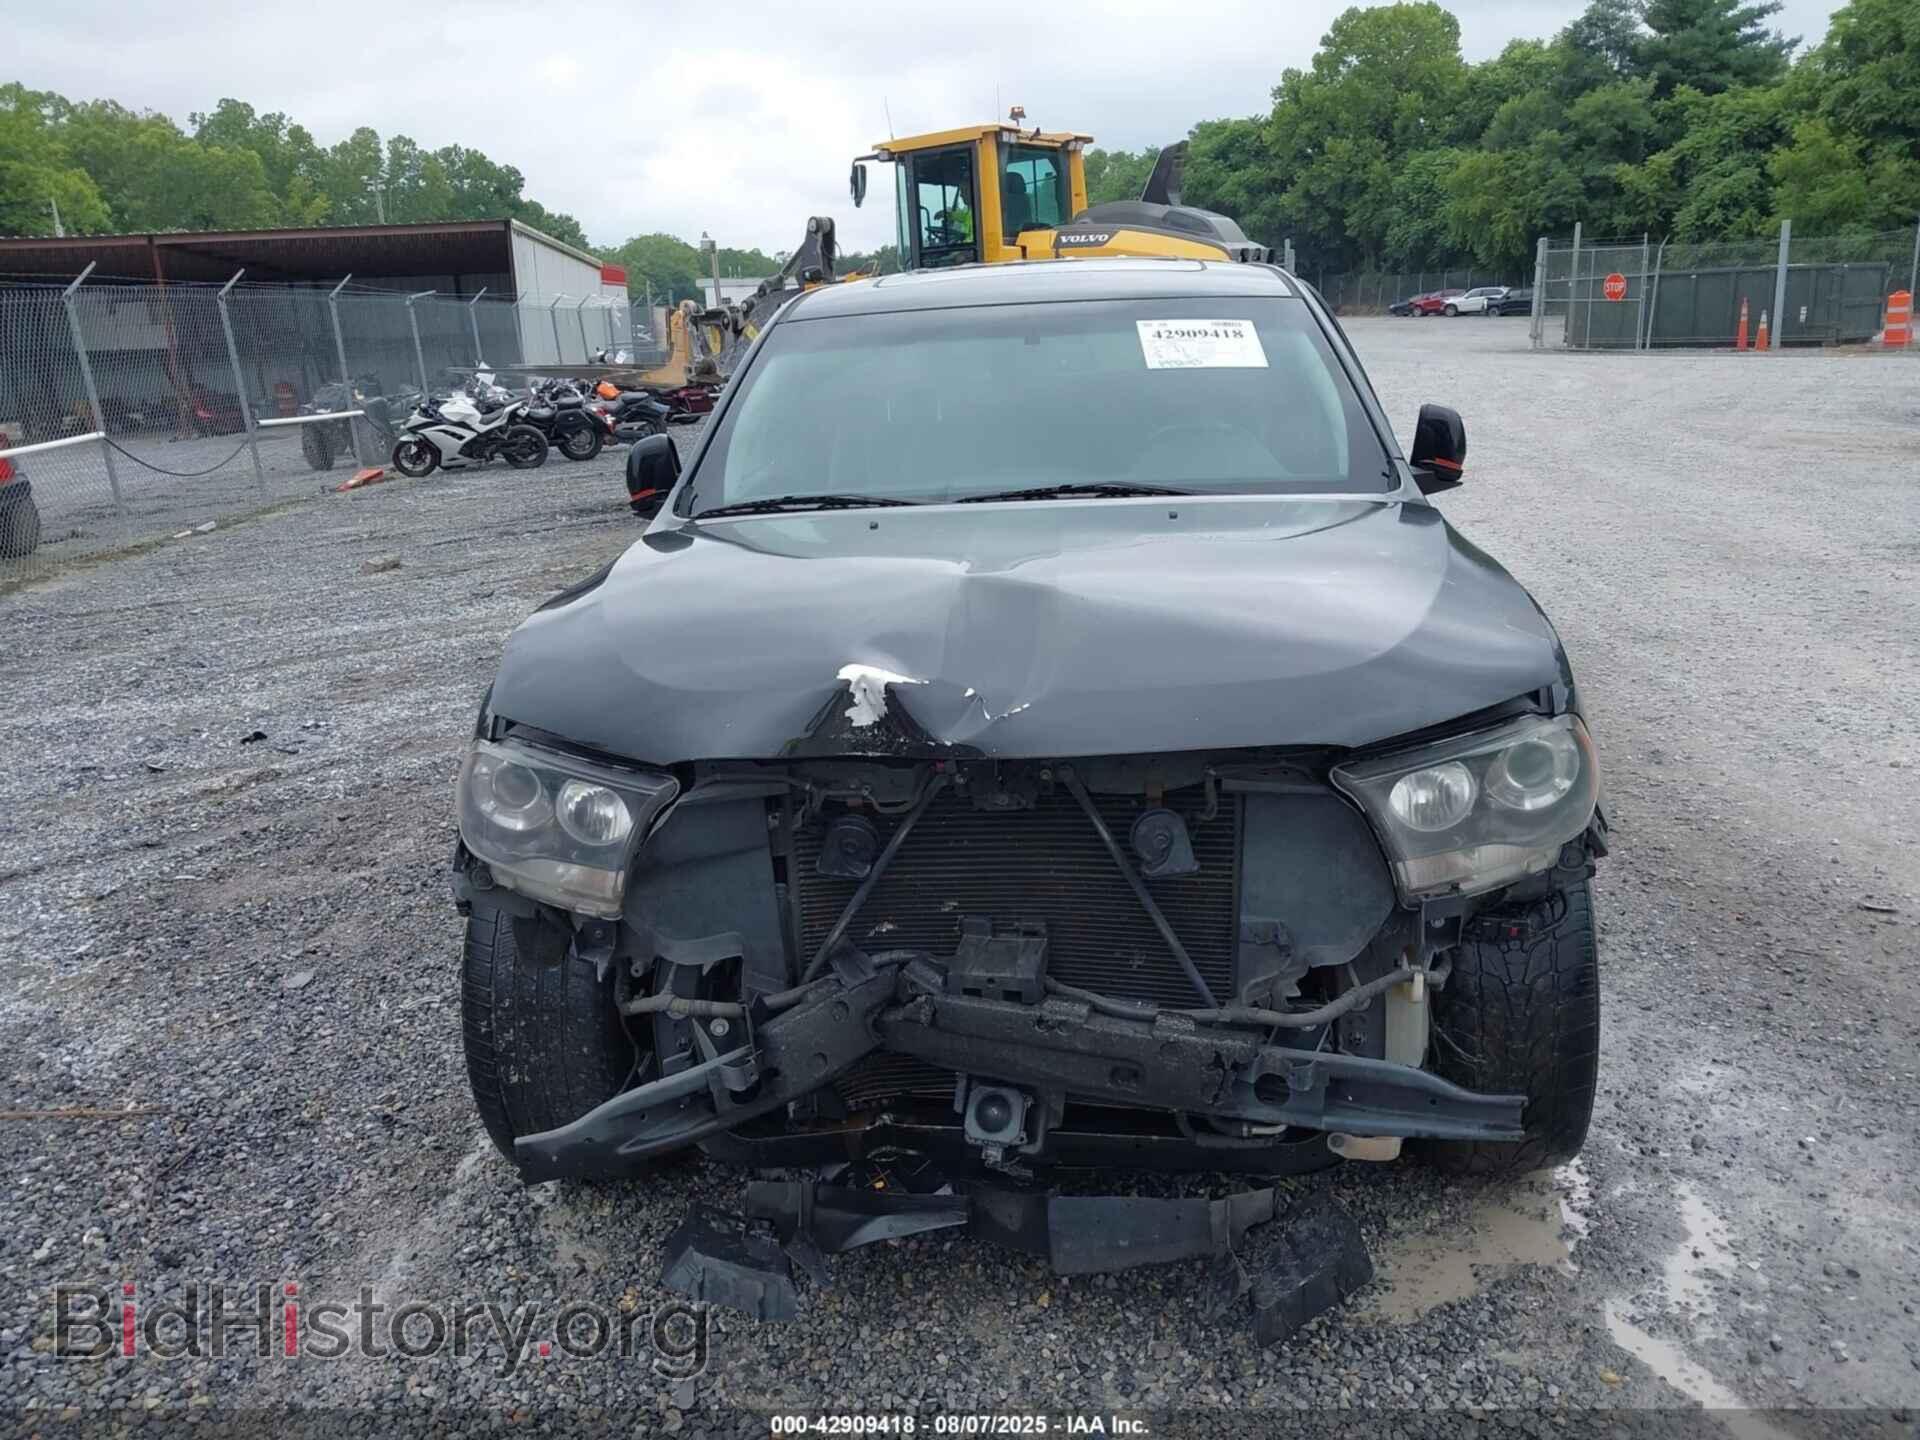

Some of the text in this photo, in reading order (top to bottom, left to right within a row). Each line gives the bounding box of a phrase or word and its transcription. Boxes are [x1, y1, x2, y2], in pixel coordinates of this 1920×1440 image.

[1060, 234, 1109, 243] VOLVO
[1606, 282, 1624, 293] STOP
[1152, 328, 1244, 339] 42909418
